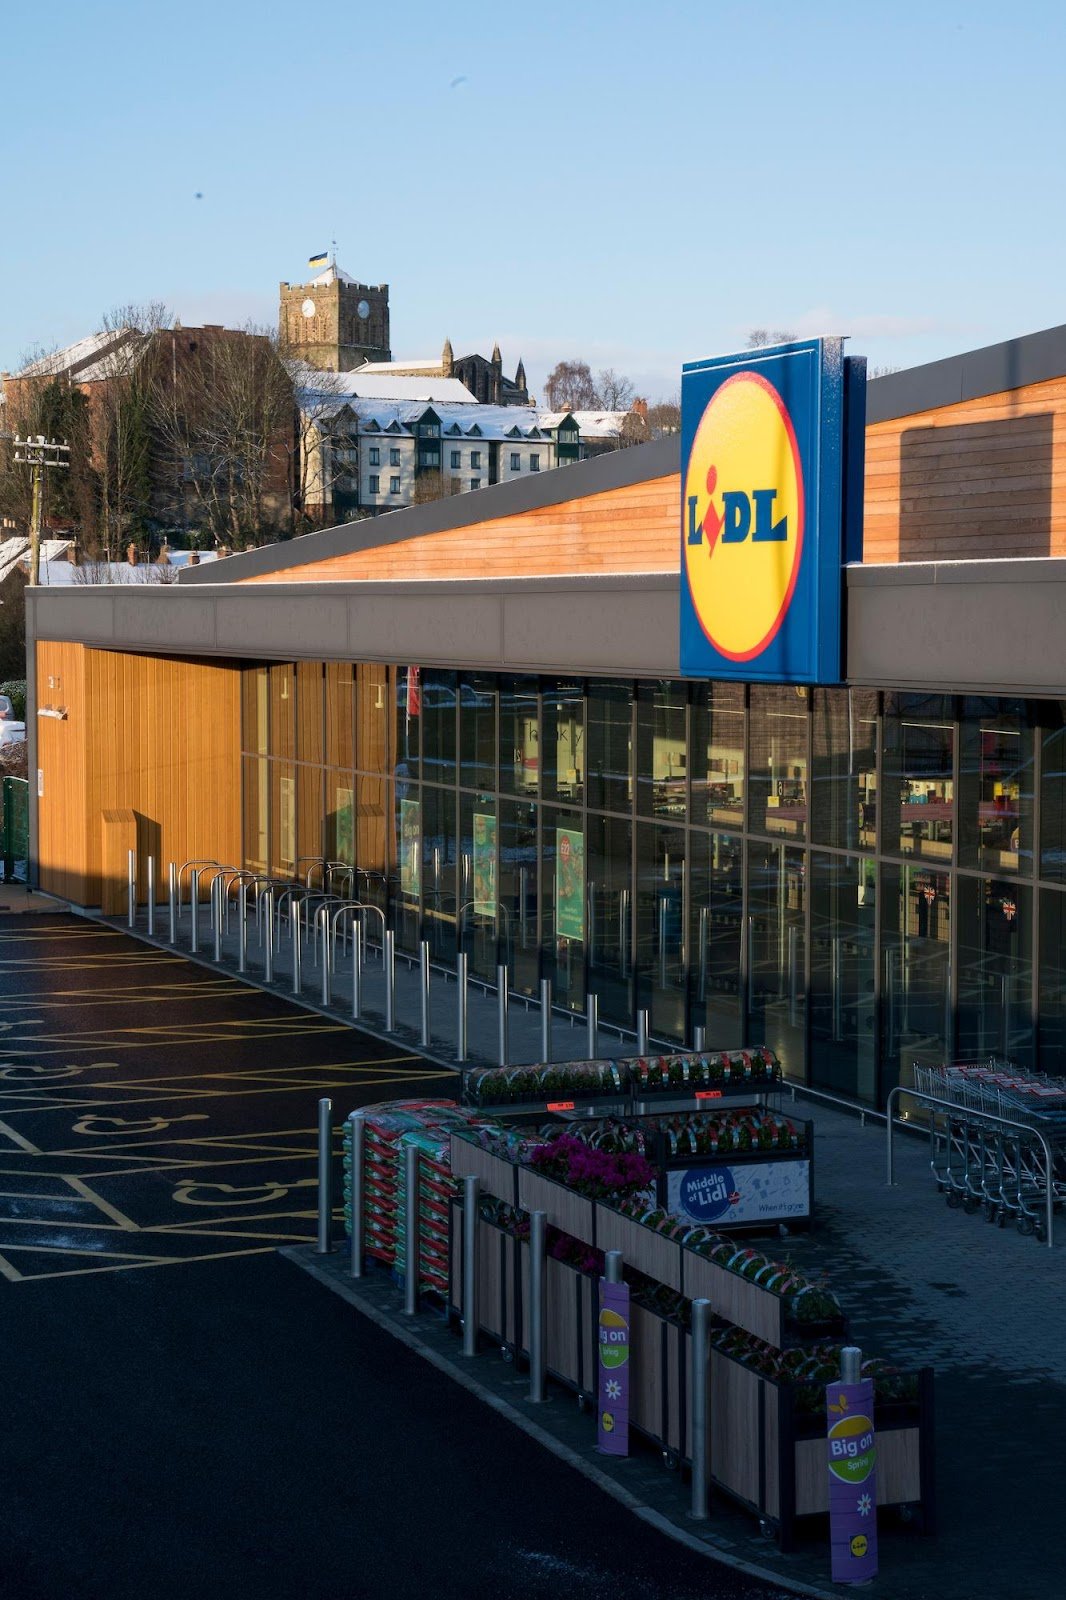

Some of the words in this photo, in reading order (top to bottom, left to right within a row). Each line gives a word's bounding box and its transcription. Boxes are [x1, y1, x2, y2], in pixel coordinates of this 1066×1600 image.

[687, 1173, 724, 1194] Middle
[688, 1192, 697, 1202] of
[698, 1182, 728, 1206] Lidl
[609, 1331, 626, 1342] on
[831, 1438, 858, 1457] Big
[860, 1433, 872, 1449] on
